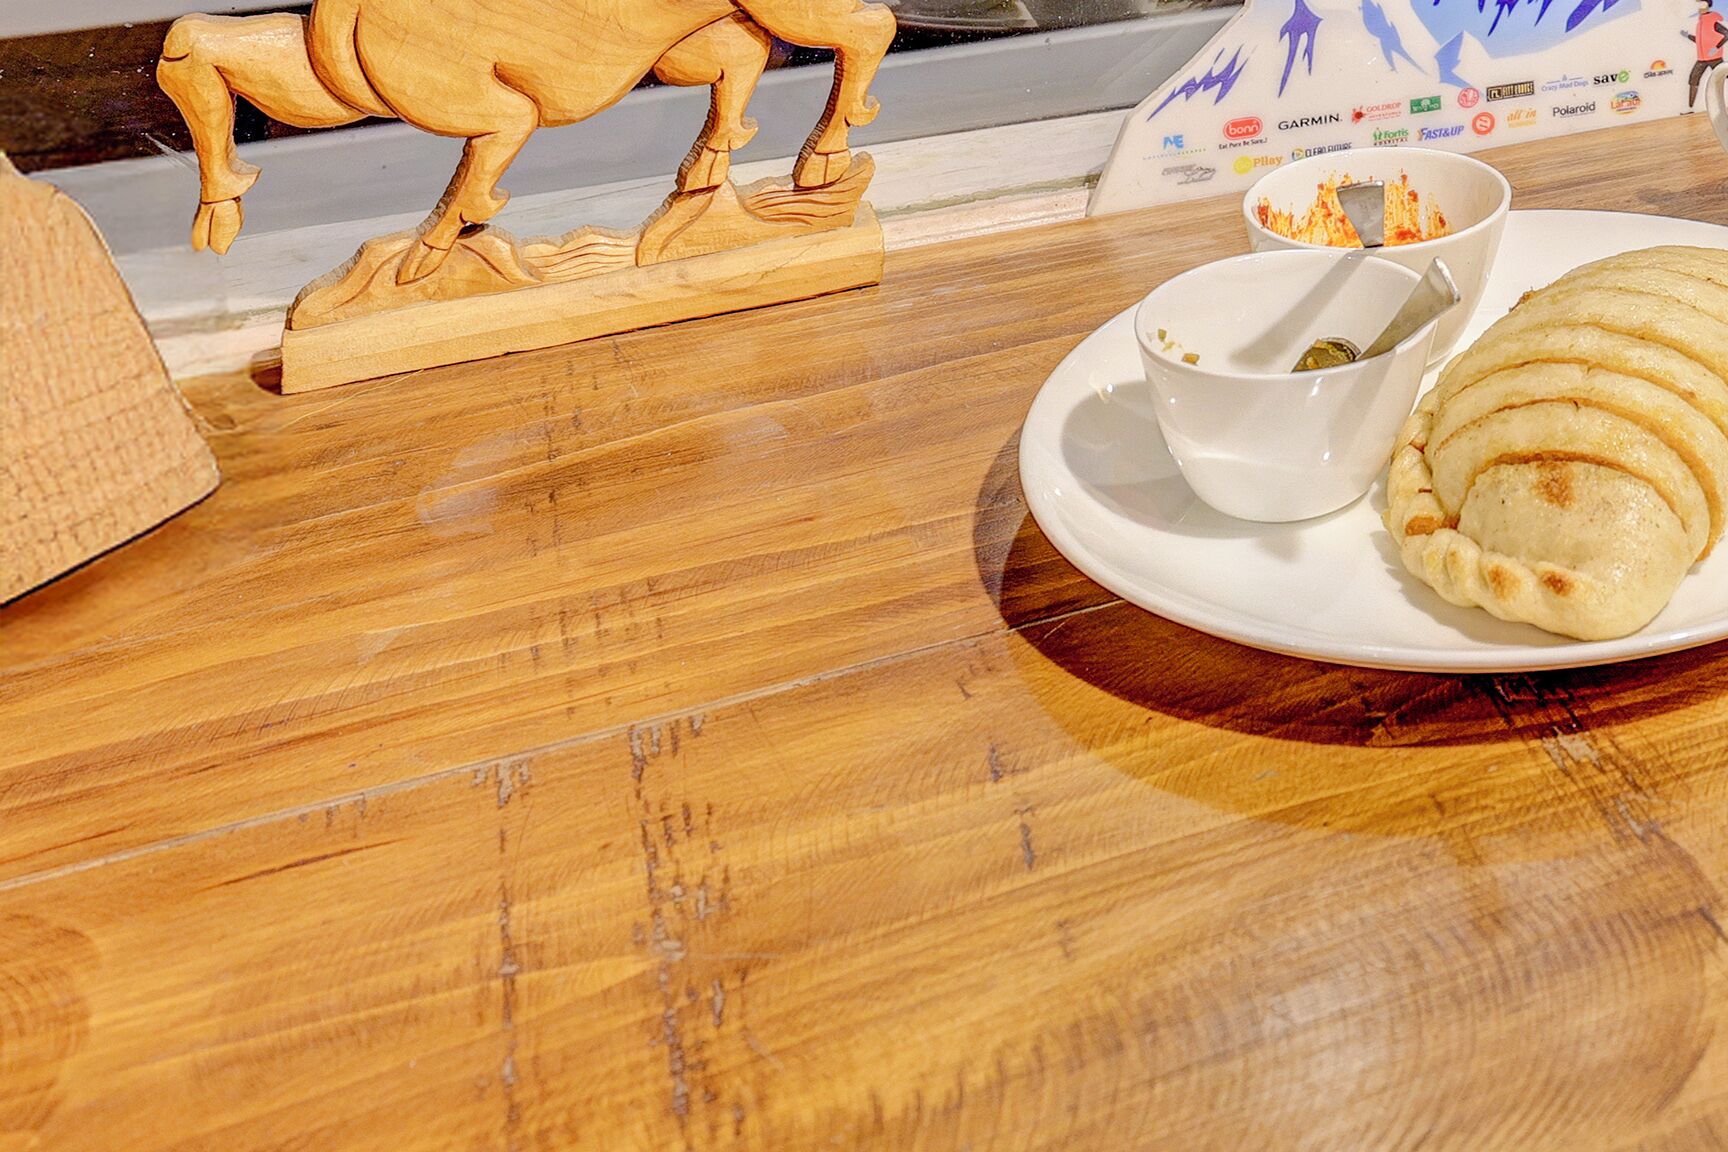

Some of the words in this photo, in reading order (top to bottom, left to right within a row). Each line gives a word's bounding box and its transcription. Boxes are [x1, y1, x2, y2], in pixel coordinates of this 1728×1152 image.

[1593, 70, 1630, 85] save
[1366, 102, 1402, 113] GOLDROP
[1552, 101, 1596, 117] Polaroid
[1229, 123, 1259, 135] bonn
[1278, 113, 1340, 131] GARMIN
[1420, 125, 1465, 141] FAST&UP
